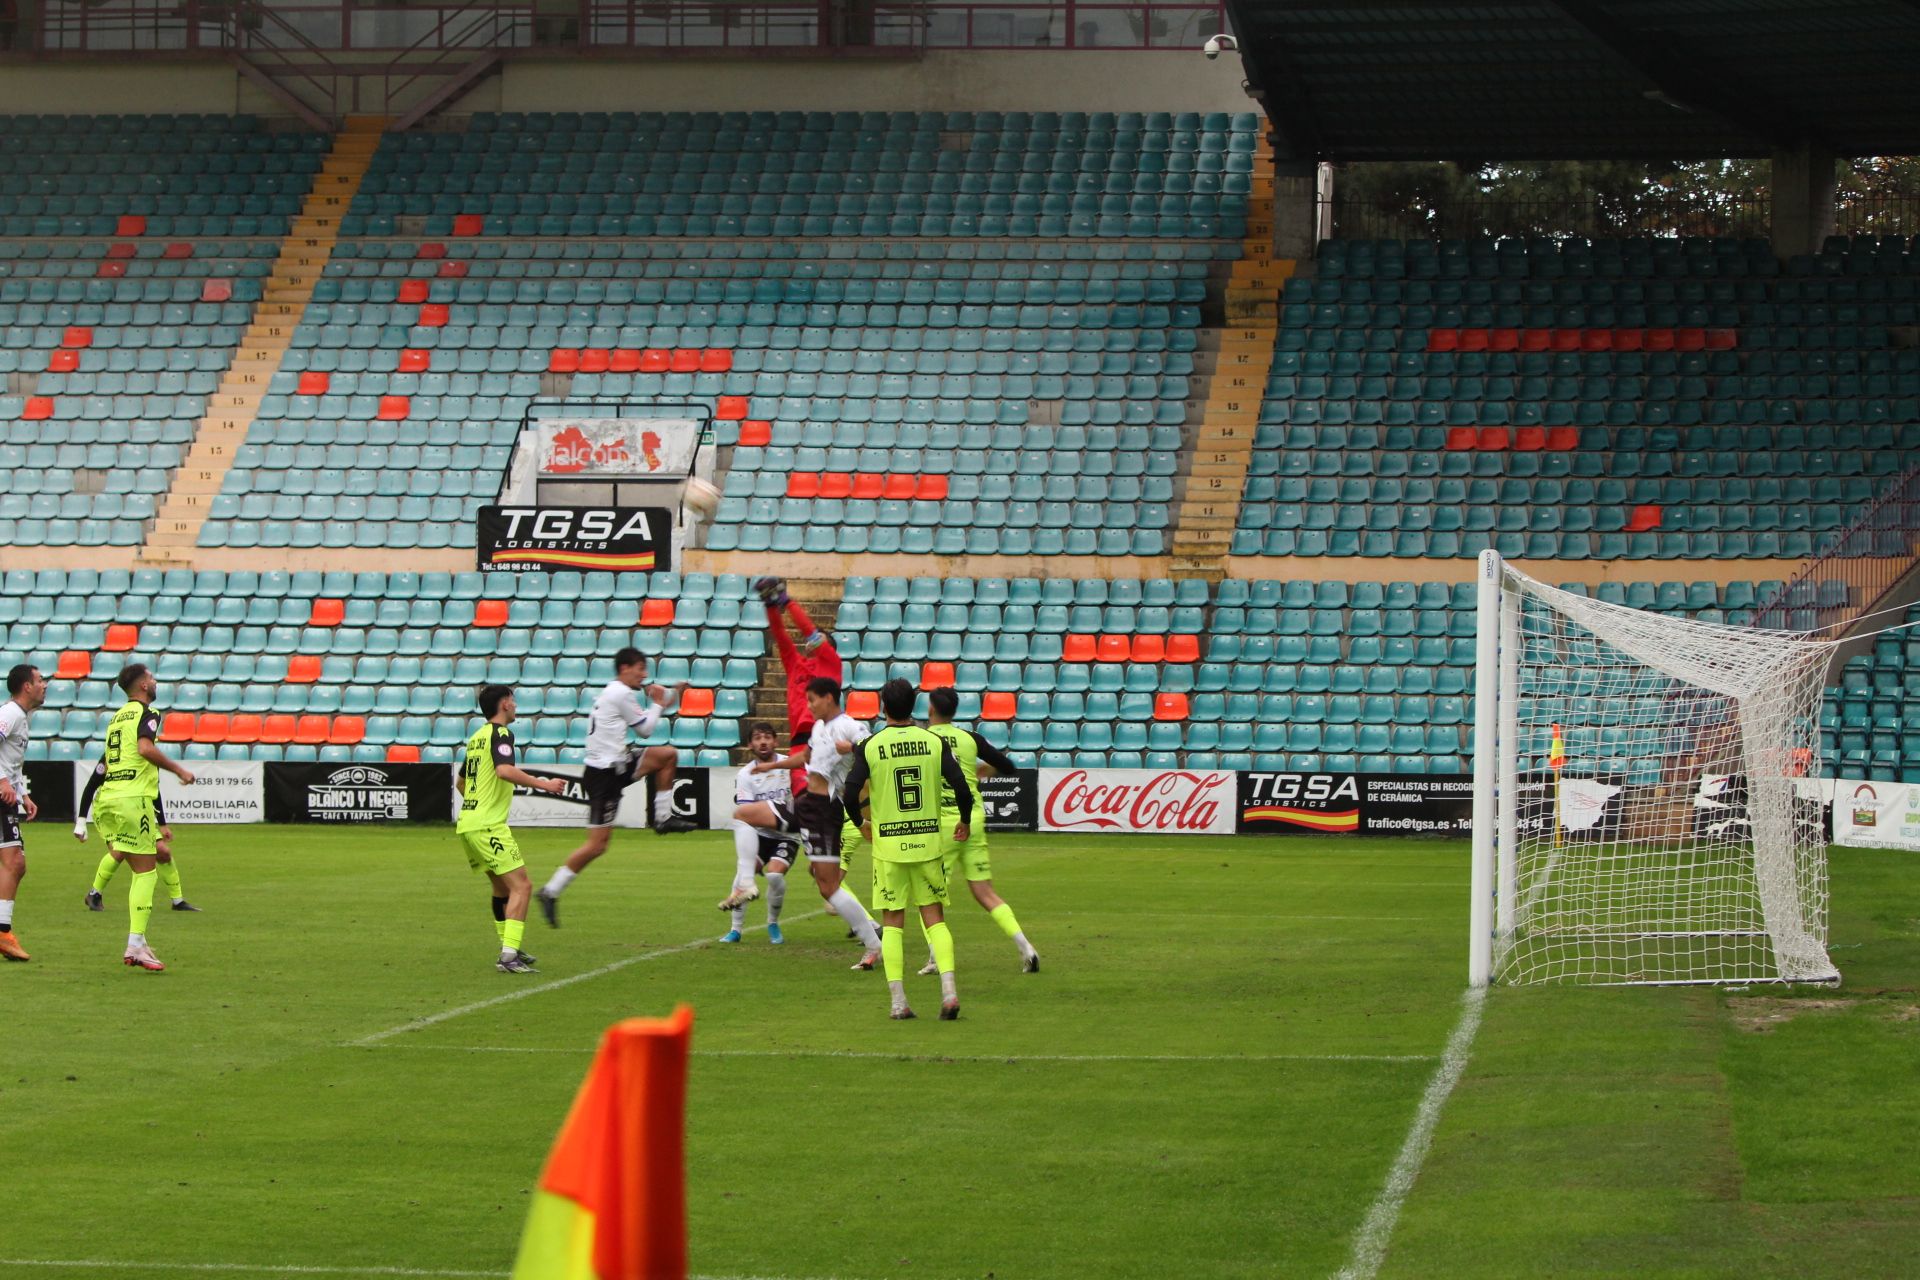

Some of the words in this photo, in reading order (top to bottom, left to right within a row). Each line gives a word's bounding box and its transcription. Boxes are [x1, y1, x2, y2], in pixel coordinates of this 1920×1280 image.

[500, 509, 653, 541] TGSA
[495, 540, 608, 549] LOGISTICS
[522, 563, 532, 571] 43
[532, 563, 541, 571] 44
[107, 730, 122, 764] 9
[890, 741, 931, 758] CARRAL
[332, 771, 351, 781] SINCE
[893, 765, 923, 812] 6
[1248, 773, 1360, 801] TGSA
[1368, 781, 1429, 791] ESPECIALISTAS
[1430, 782, 1441, 791] EN
[308, 790, 355, 808] BLANCO
[357, 790, 366, 808] Y
[369, 790, 408, 808] NEGRO
[1044, 770, 1231, 829] Coca-Cola
[1368, 793, 1379, 802] DE
[1380, 791, 1423, 803] CERÁMICA
[165, 800, 258, 809] INMOBILIARIA
[1244, 799, 1328, 808] LOGISTICS
[343, 812, 348, 820] Y
[350, 812, 373, 820] TAPAS
[880, 823, 909, 831] GRUPO
[1368, 818, 1450, 831] trafico@tgsa.es
[12, 826, 19, 839] 9
